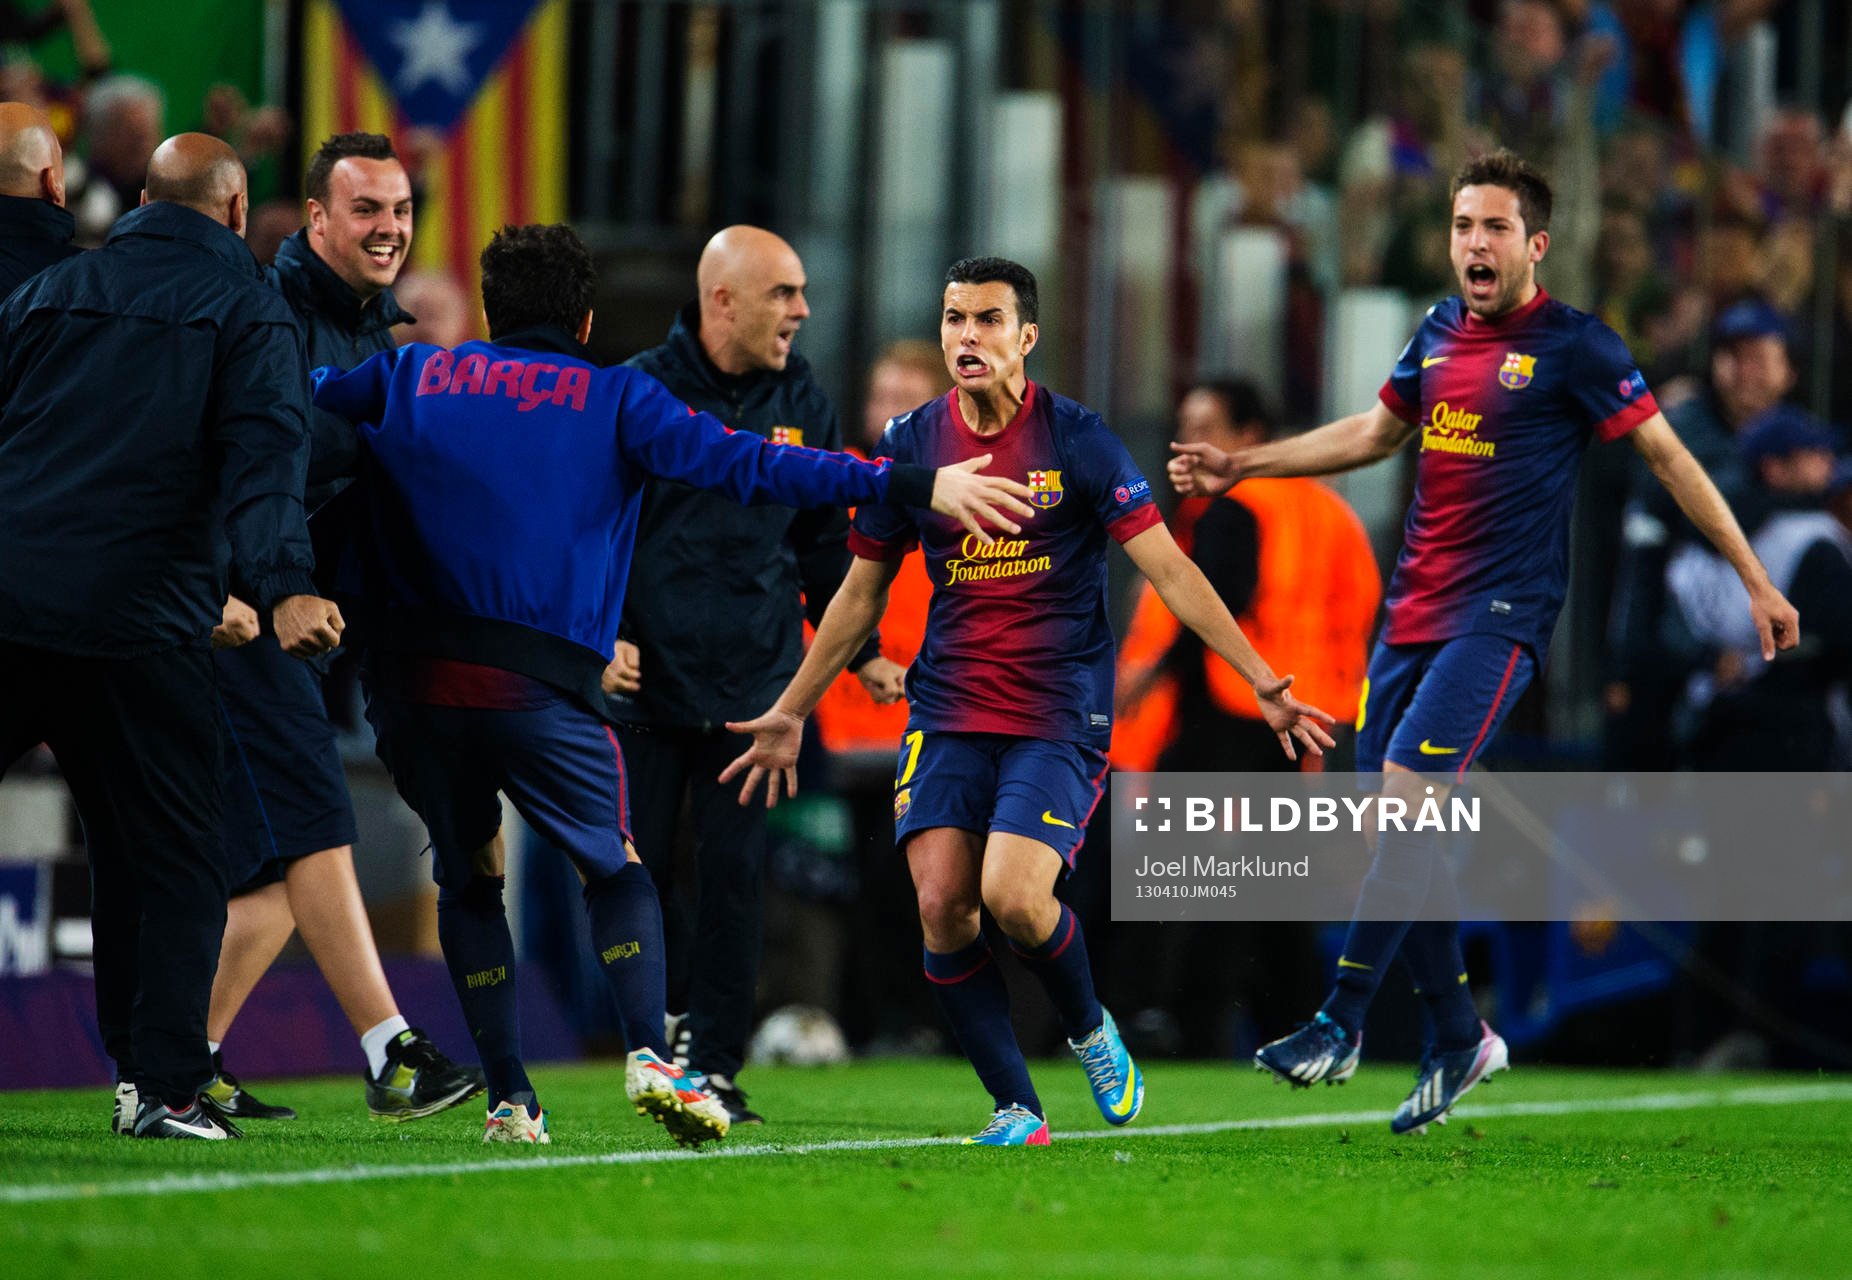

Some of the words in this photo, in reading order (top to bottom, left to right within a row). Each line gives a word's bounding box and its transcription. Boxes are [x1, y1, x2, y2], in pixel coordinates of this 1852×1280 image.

[415, 350, 591, 412] BARÇA
[1431, 401, 1483, 435] Qatar
[961, 533, 1029, 564] Qatar
[944, 555, 1052, 586] Foundation
